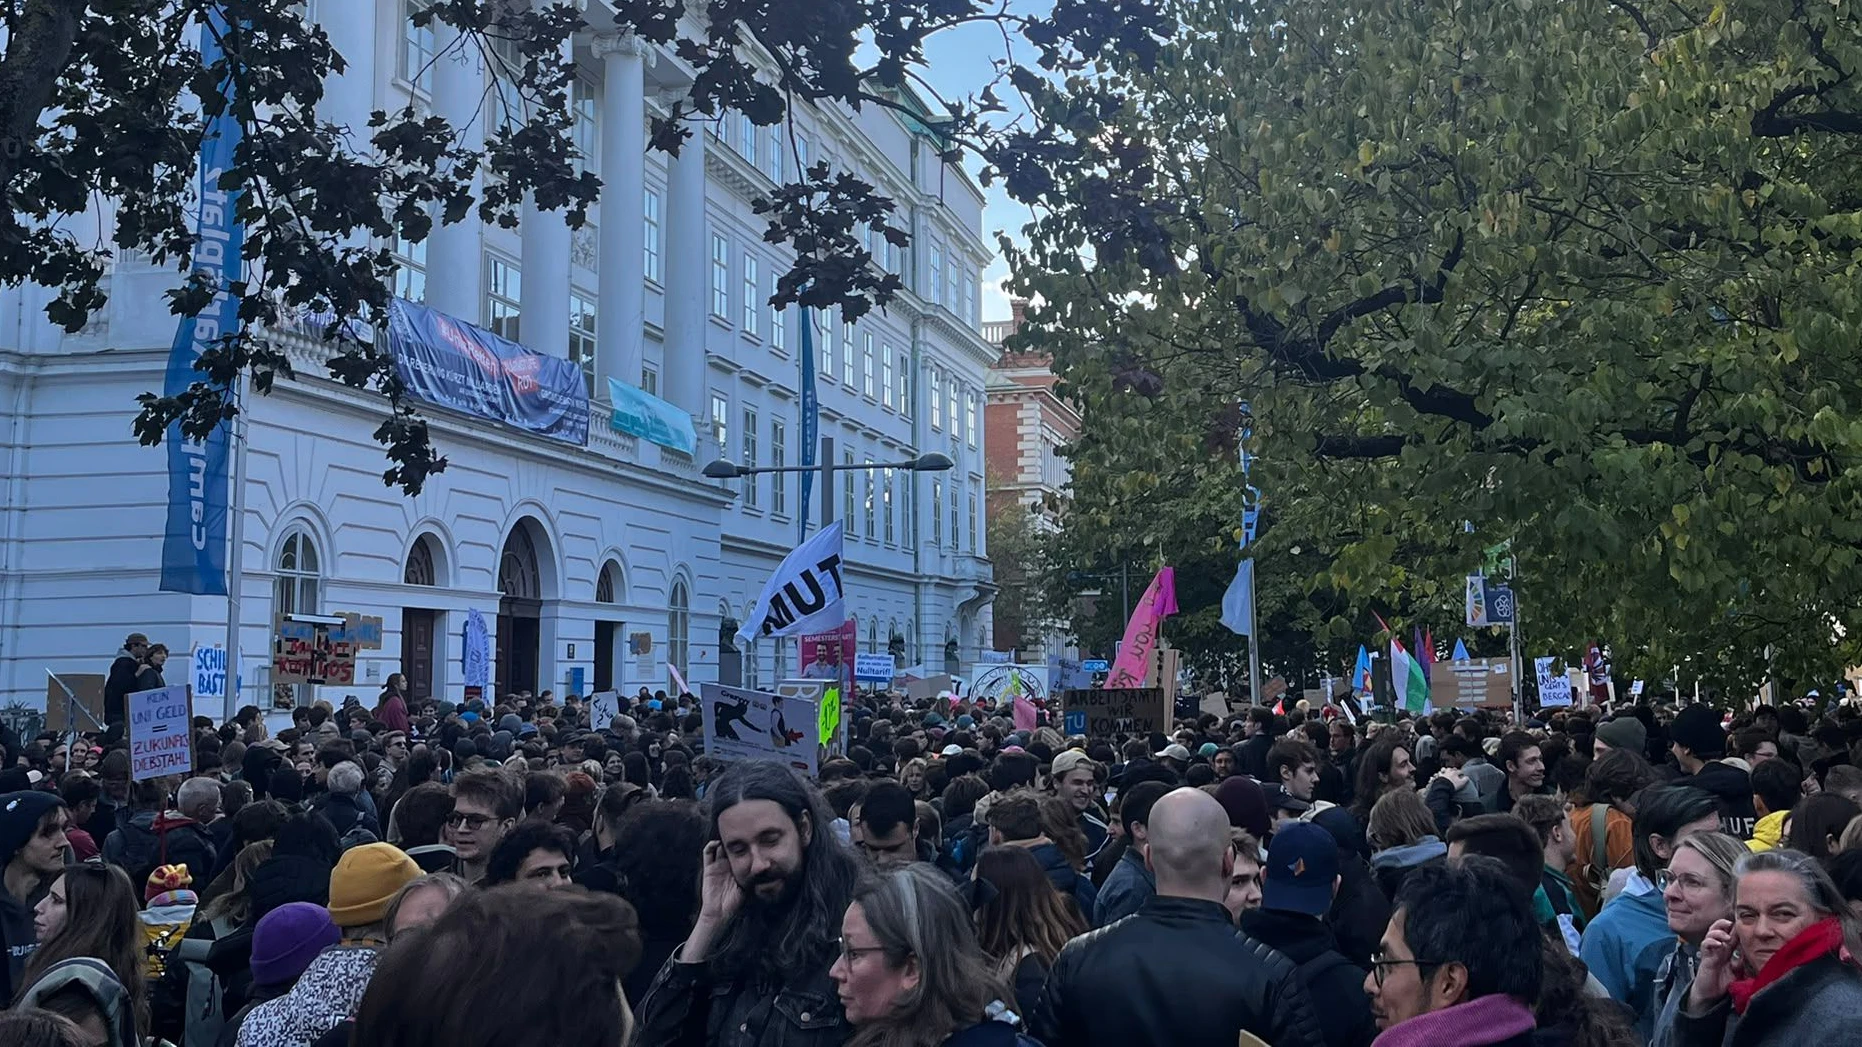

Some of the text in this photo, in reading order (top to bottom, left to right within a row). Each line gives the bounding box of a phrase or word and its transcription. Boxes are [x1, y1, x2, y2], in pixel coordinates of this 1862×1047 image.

[517, 375, 533, 391] ROT
[762, 552, 844, 635] MUT
[146, 691, 169, 704] KEIN
[132, 704, 186, 725] UNI GELD
[1065, 714, 1085, 732] TU
[1089, 718, 1154, 734] KOMMEN
[134, 751, 190, 773] DIEBSTAHL
